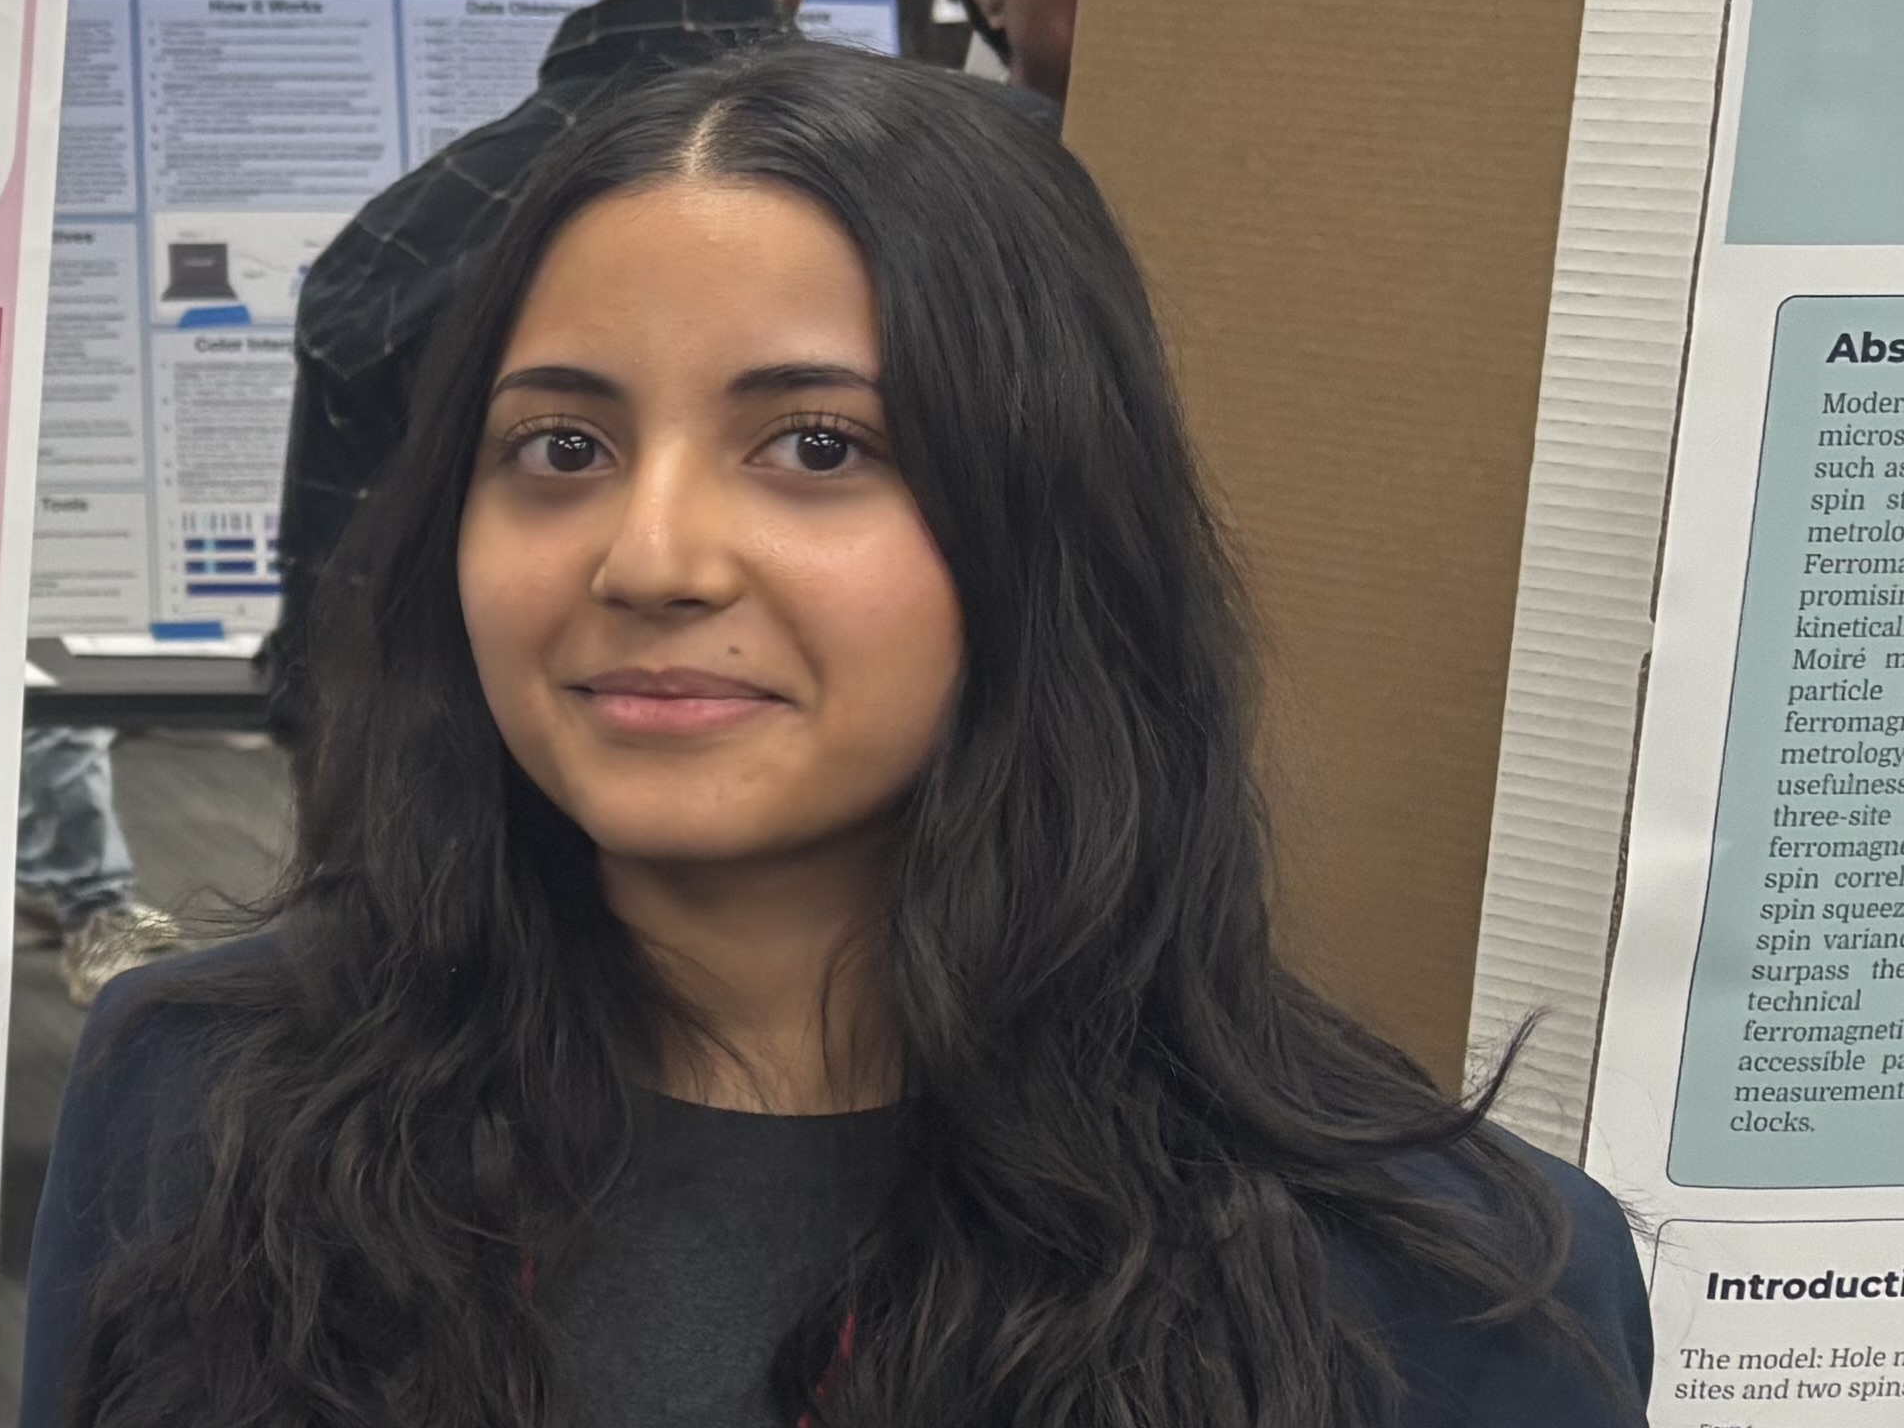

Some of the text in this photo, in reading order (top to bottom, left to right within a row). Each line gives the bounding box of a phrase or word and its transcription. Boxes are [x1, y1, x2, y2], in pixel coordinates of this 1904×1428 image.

[1822, 391, 1904, 414] Moder
[1814, 456, 1874, 478] such
[1811, 489, 1864, 515] spin
[1795, 615, 1904, 639] kinetical
[1792, 647, 1866, 670] Moiré
[1788, 678, 1883, 706] particle
[1774, 805, 1891, 827] three-site
[1764, 867, 1818, 893] spin
[1760, 898, 1904, 924] spin squeez
[1751, 962, 1849, 986] surpass
[1748, 988, 1861, 1012] technical
[1738, 1050, 1865, 1073] accessible
[1731, 1111, 1815, 1133] clocks.
[1680, 1346, 1886, 1370] The model: Hole
[1674, 1378, 1841, 1400] sites and two
